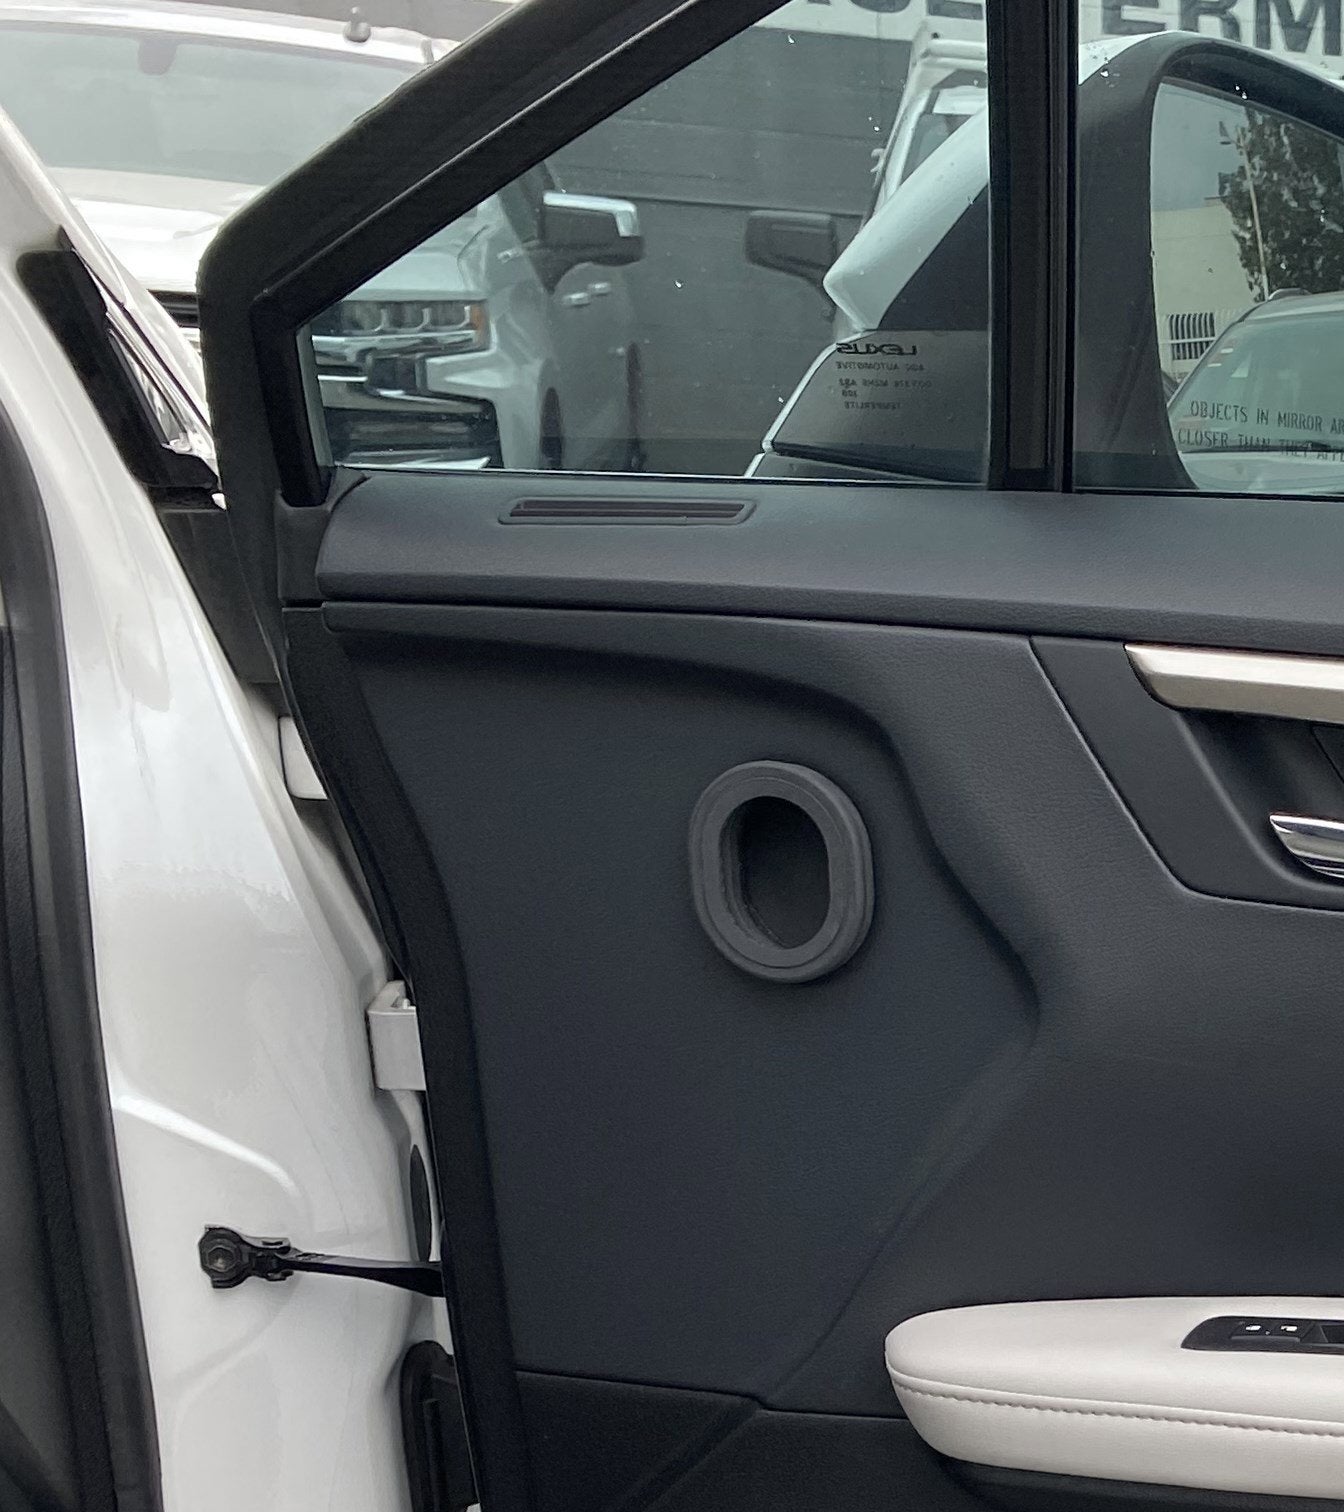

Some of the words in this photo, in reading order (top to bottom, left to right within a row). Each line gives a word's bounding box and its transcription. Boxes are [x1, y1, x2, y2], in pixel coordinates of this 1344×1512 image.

[1190, 400, 1248, 424] OBJECTS
[1256, 408, 1270, 426] IN
[1277, 411, 1322, 432] MIRROR
[1178, 429, 1229, 448] CLOSER
